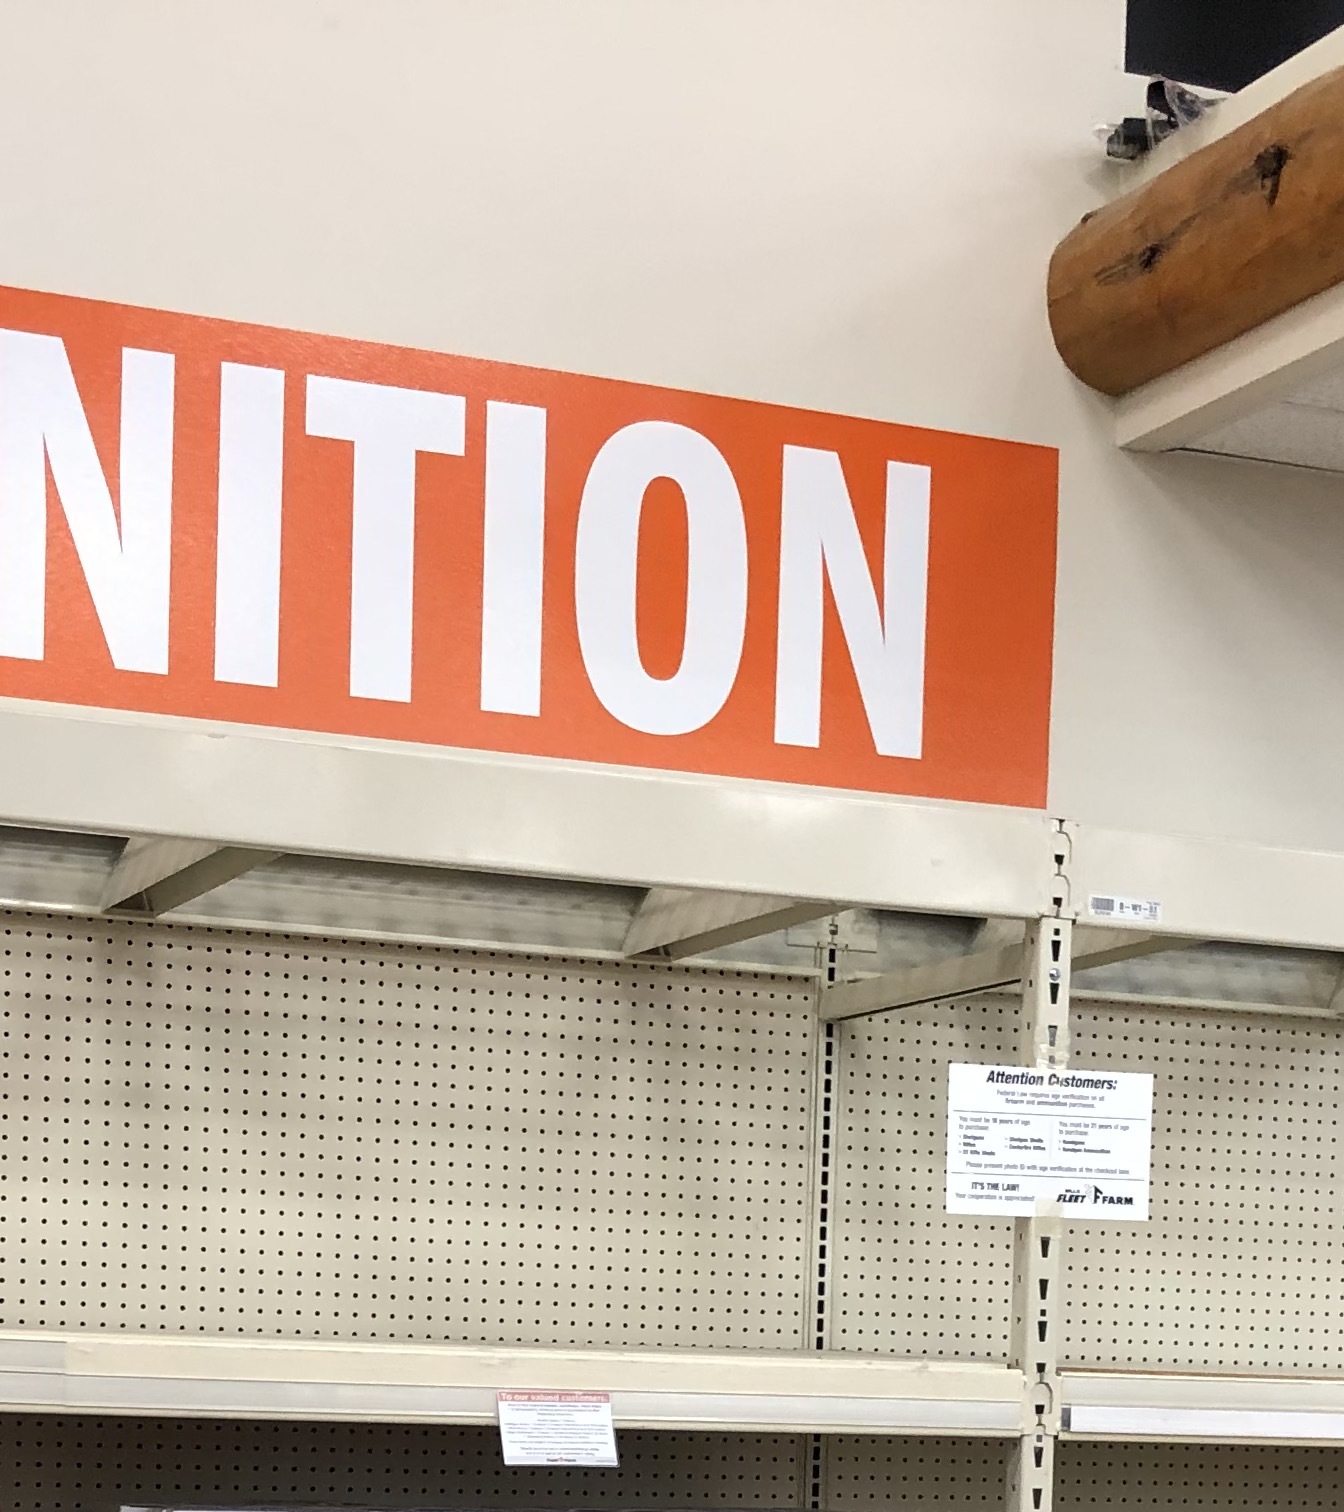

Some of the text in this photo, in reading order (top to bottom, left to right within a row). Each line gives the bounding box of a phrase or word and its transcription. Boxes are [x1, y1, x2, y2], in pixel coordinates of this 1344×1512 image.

[987, 1070, 1117, 1089] Attention Customers:
[972, 1182, 984, 1190] IT'S
[987, 1183, 999, 1191] THE
[1057, 1194, 1133, 1205] FLEET FARM
